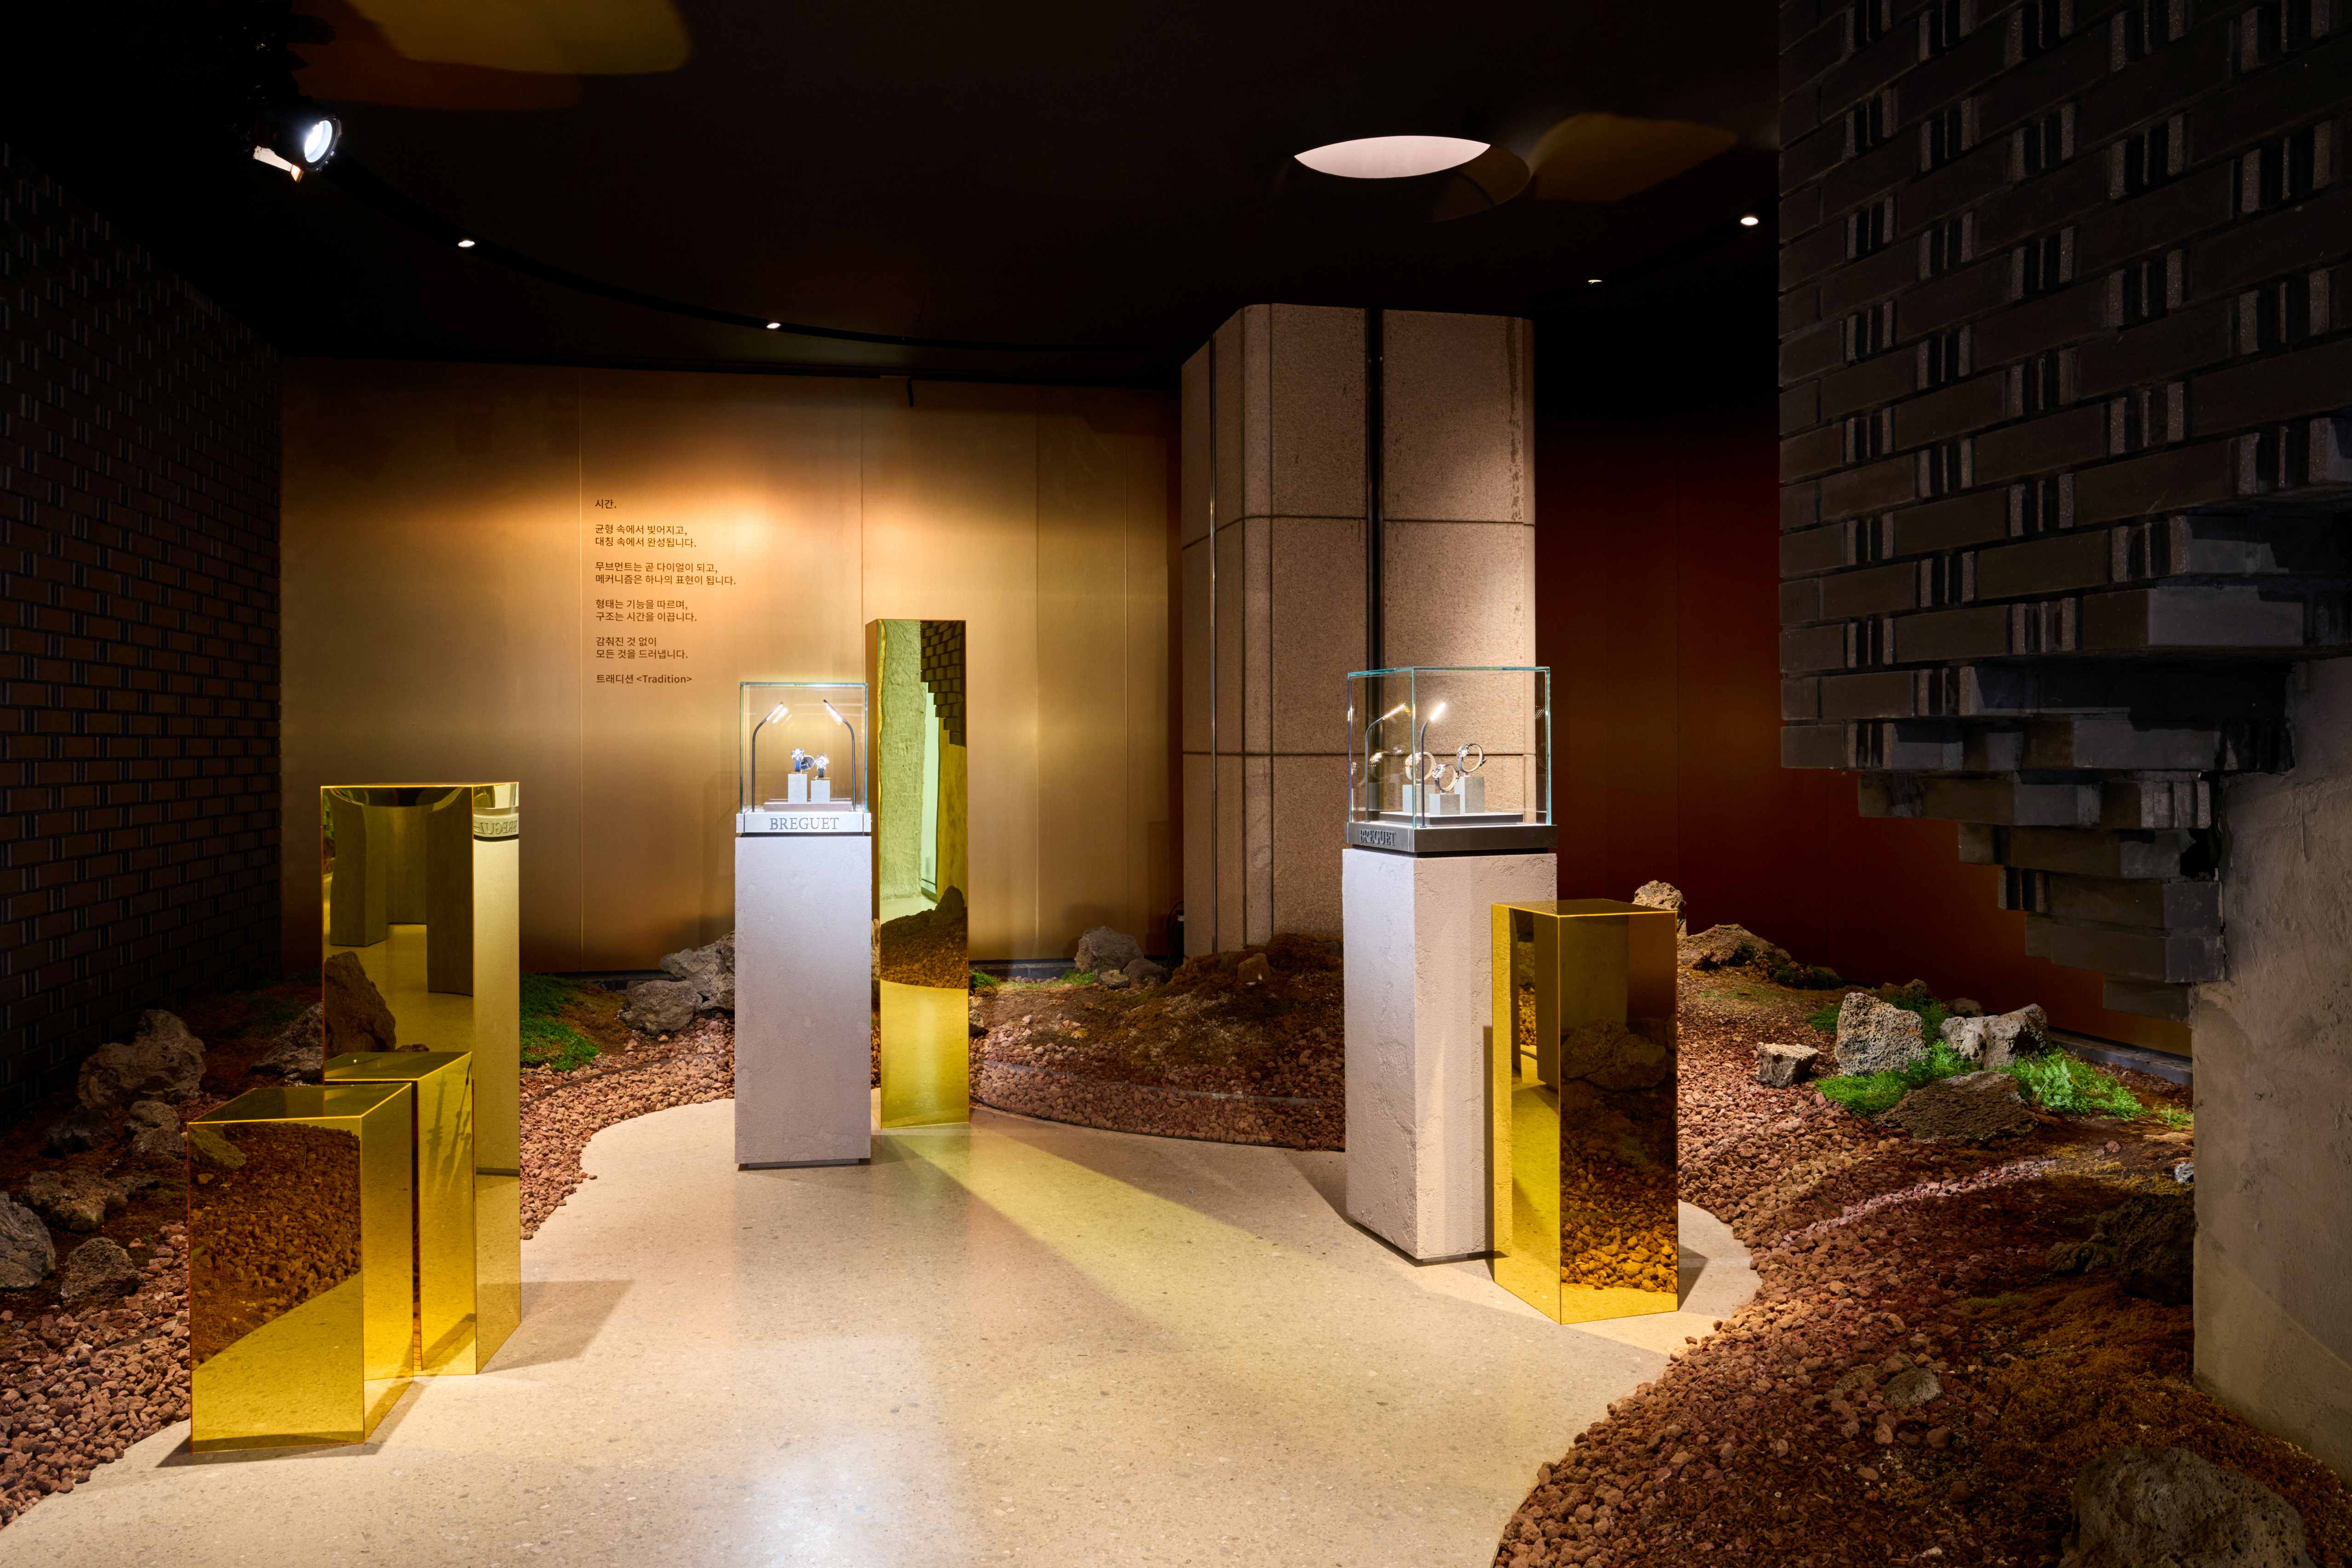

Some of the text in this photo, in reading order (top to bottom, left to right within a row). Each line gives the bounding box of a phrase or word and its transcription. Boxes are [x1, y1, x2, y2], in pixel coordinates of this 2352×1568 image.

[595, 499, 617, 509] 시간.
[595, 524, 687, 536] 균형 속에서 빚어지고,
[595, 537, 696, 548] 대칭 속에서 완성됩니다.
[595, 562, 718, 574] 무브먼트는 곧 다이얼이 되고,
[595, 574, 736, 585] 메커니즘은 하나의 표현이 됩니다.
[596, 599, 688, 611] 형태는 기능을 따르며,
[596, 612, 697, 622] 구조는 시간을 이끕니다.
[596, 637, 657, 646] 감춰진 것 없이
[596, 649, 688, 659] 모든 것을 드러냅니다.
[596, 674, 692, 684] 트래디션 <Tradition>
[769, 817, 839, 830] BREGUET
[1360, 829, 1396, 846] BREGUET
